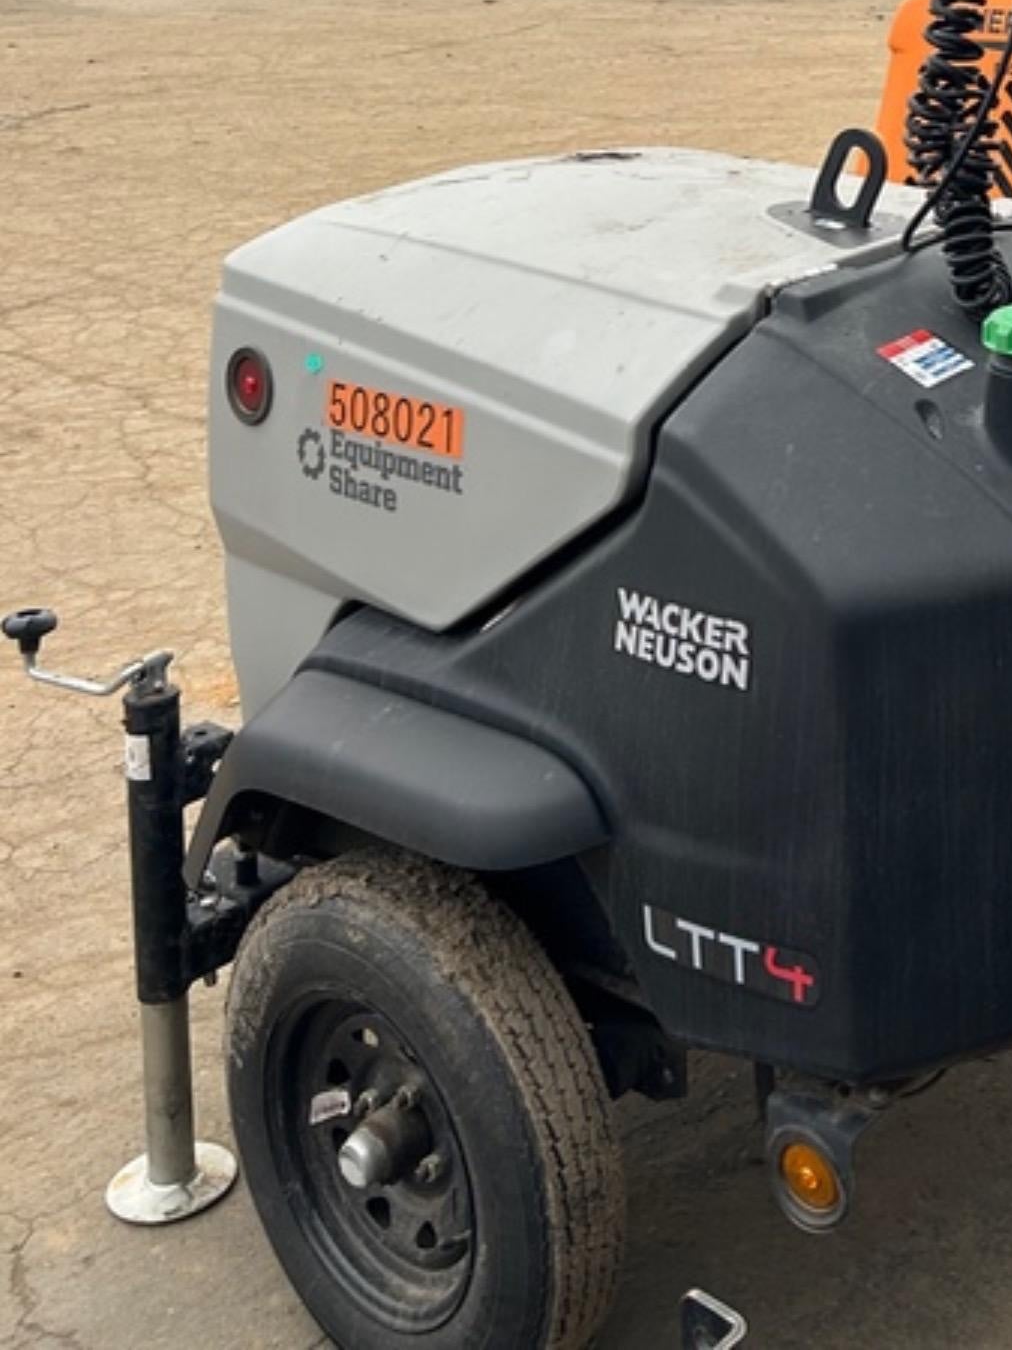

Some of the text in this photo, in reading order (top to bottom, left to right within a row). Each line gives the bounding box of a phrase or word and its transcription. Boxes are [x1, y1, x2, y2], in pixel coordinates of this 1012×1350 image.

[328, 382, 454, 453] 508021
[329, 428, 464, 494] Equipment
[329, 466, 397, 512] Share
[616, 588, 749, 654] WACKER
[614, 621, 749, 691] NEUSON
[643, 904, 814, 1003] LTT4
